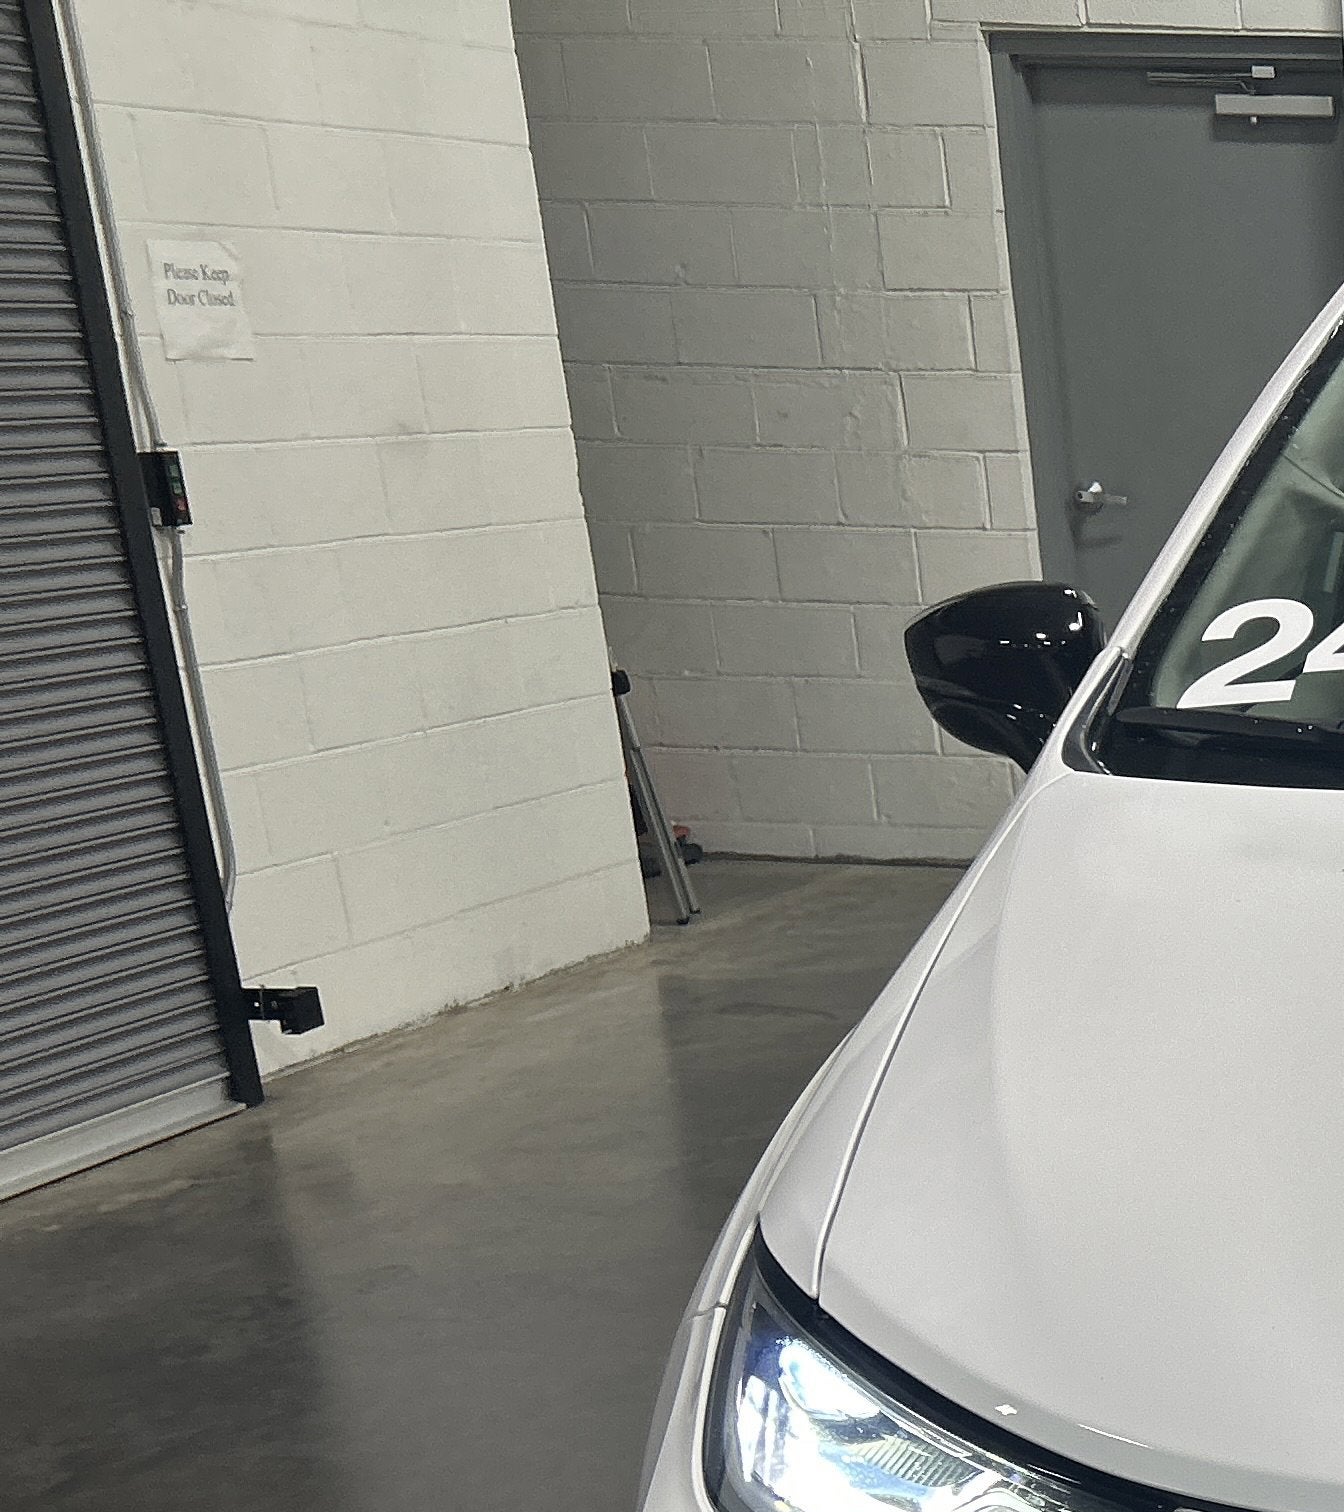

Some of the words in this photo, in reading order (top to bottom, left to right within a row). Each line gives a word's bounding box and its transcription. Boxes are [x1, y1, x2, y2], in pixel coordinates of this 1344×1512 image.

[163, 262, 198, 280] Please
[199, 263, 229, 285] Keep
[167, 289, 196, 306] Door
[198, 289, 236, 307] Closed
